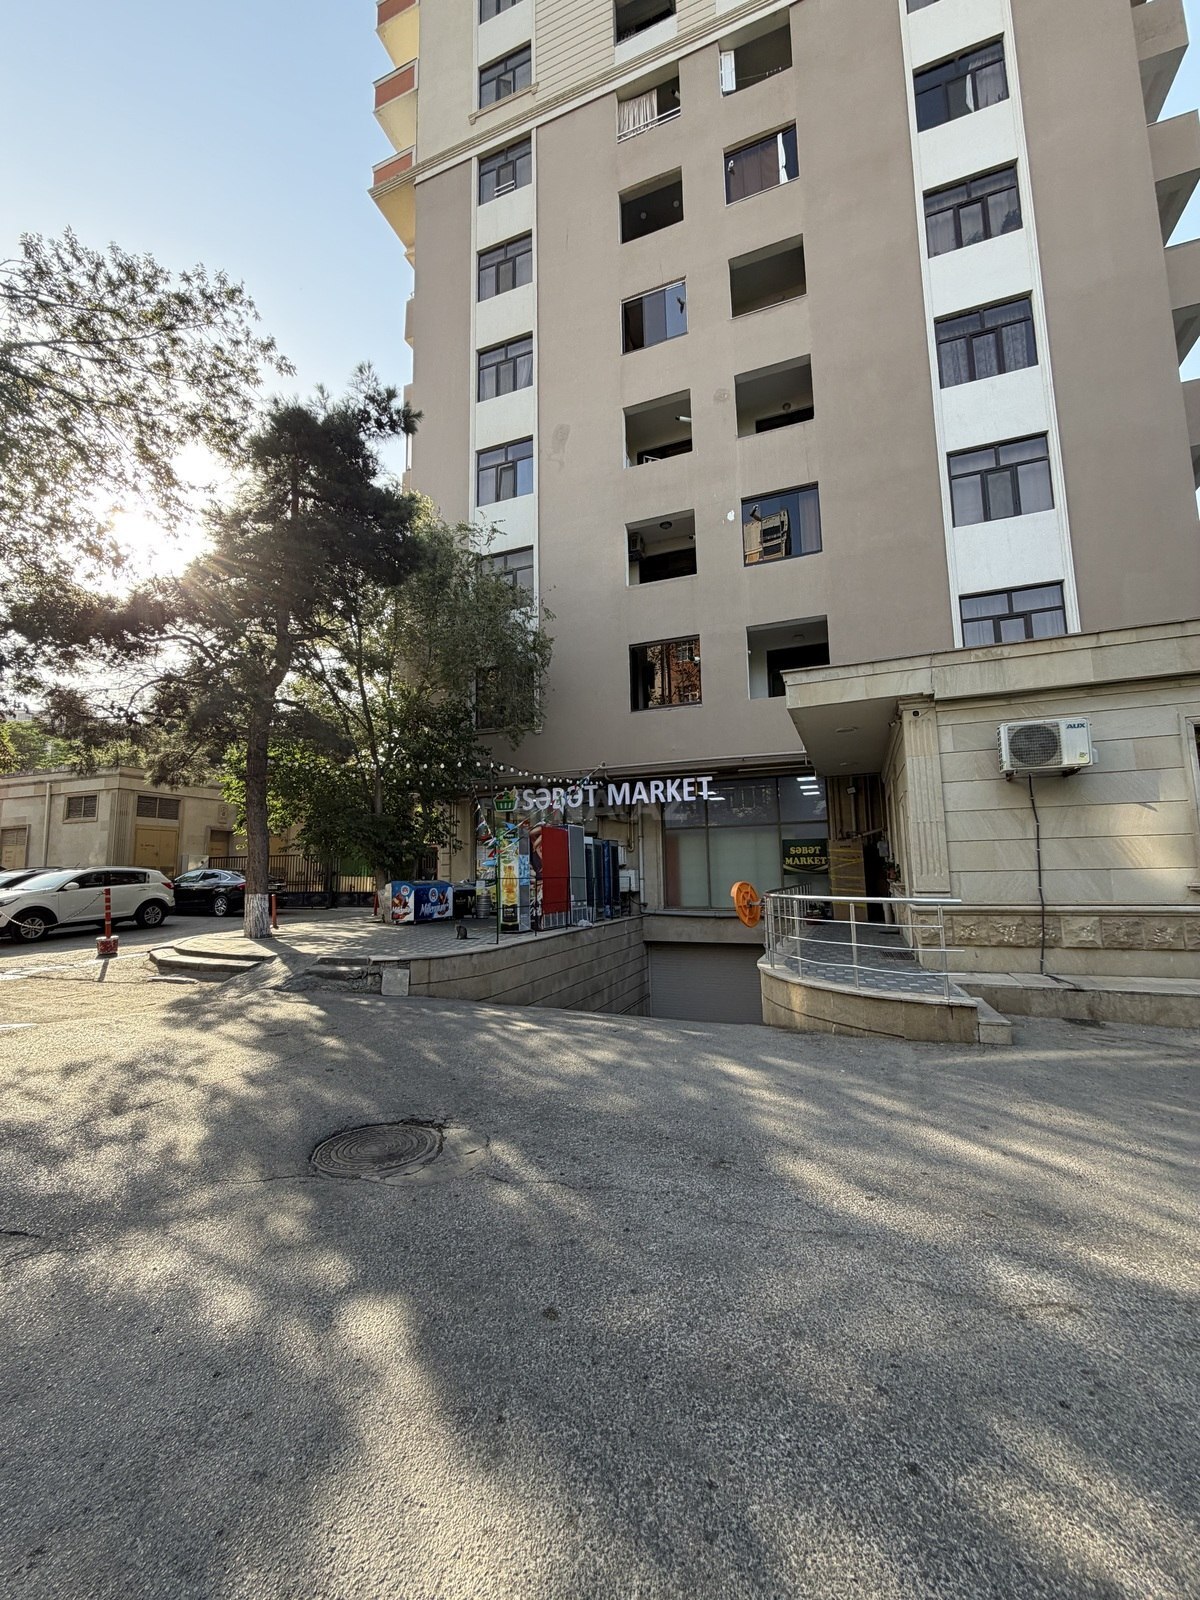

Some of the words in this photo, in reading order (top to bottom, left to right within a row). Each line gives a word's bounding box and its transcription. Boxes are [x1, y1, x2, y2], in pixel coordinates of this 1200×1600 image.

[607, 776, 713, 806] MARKET
[790, 846, 820, 854] SƏBƏT
[785, 857, 826, 865] MARKET
